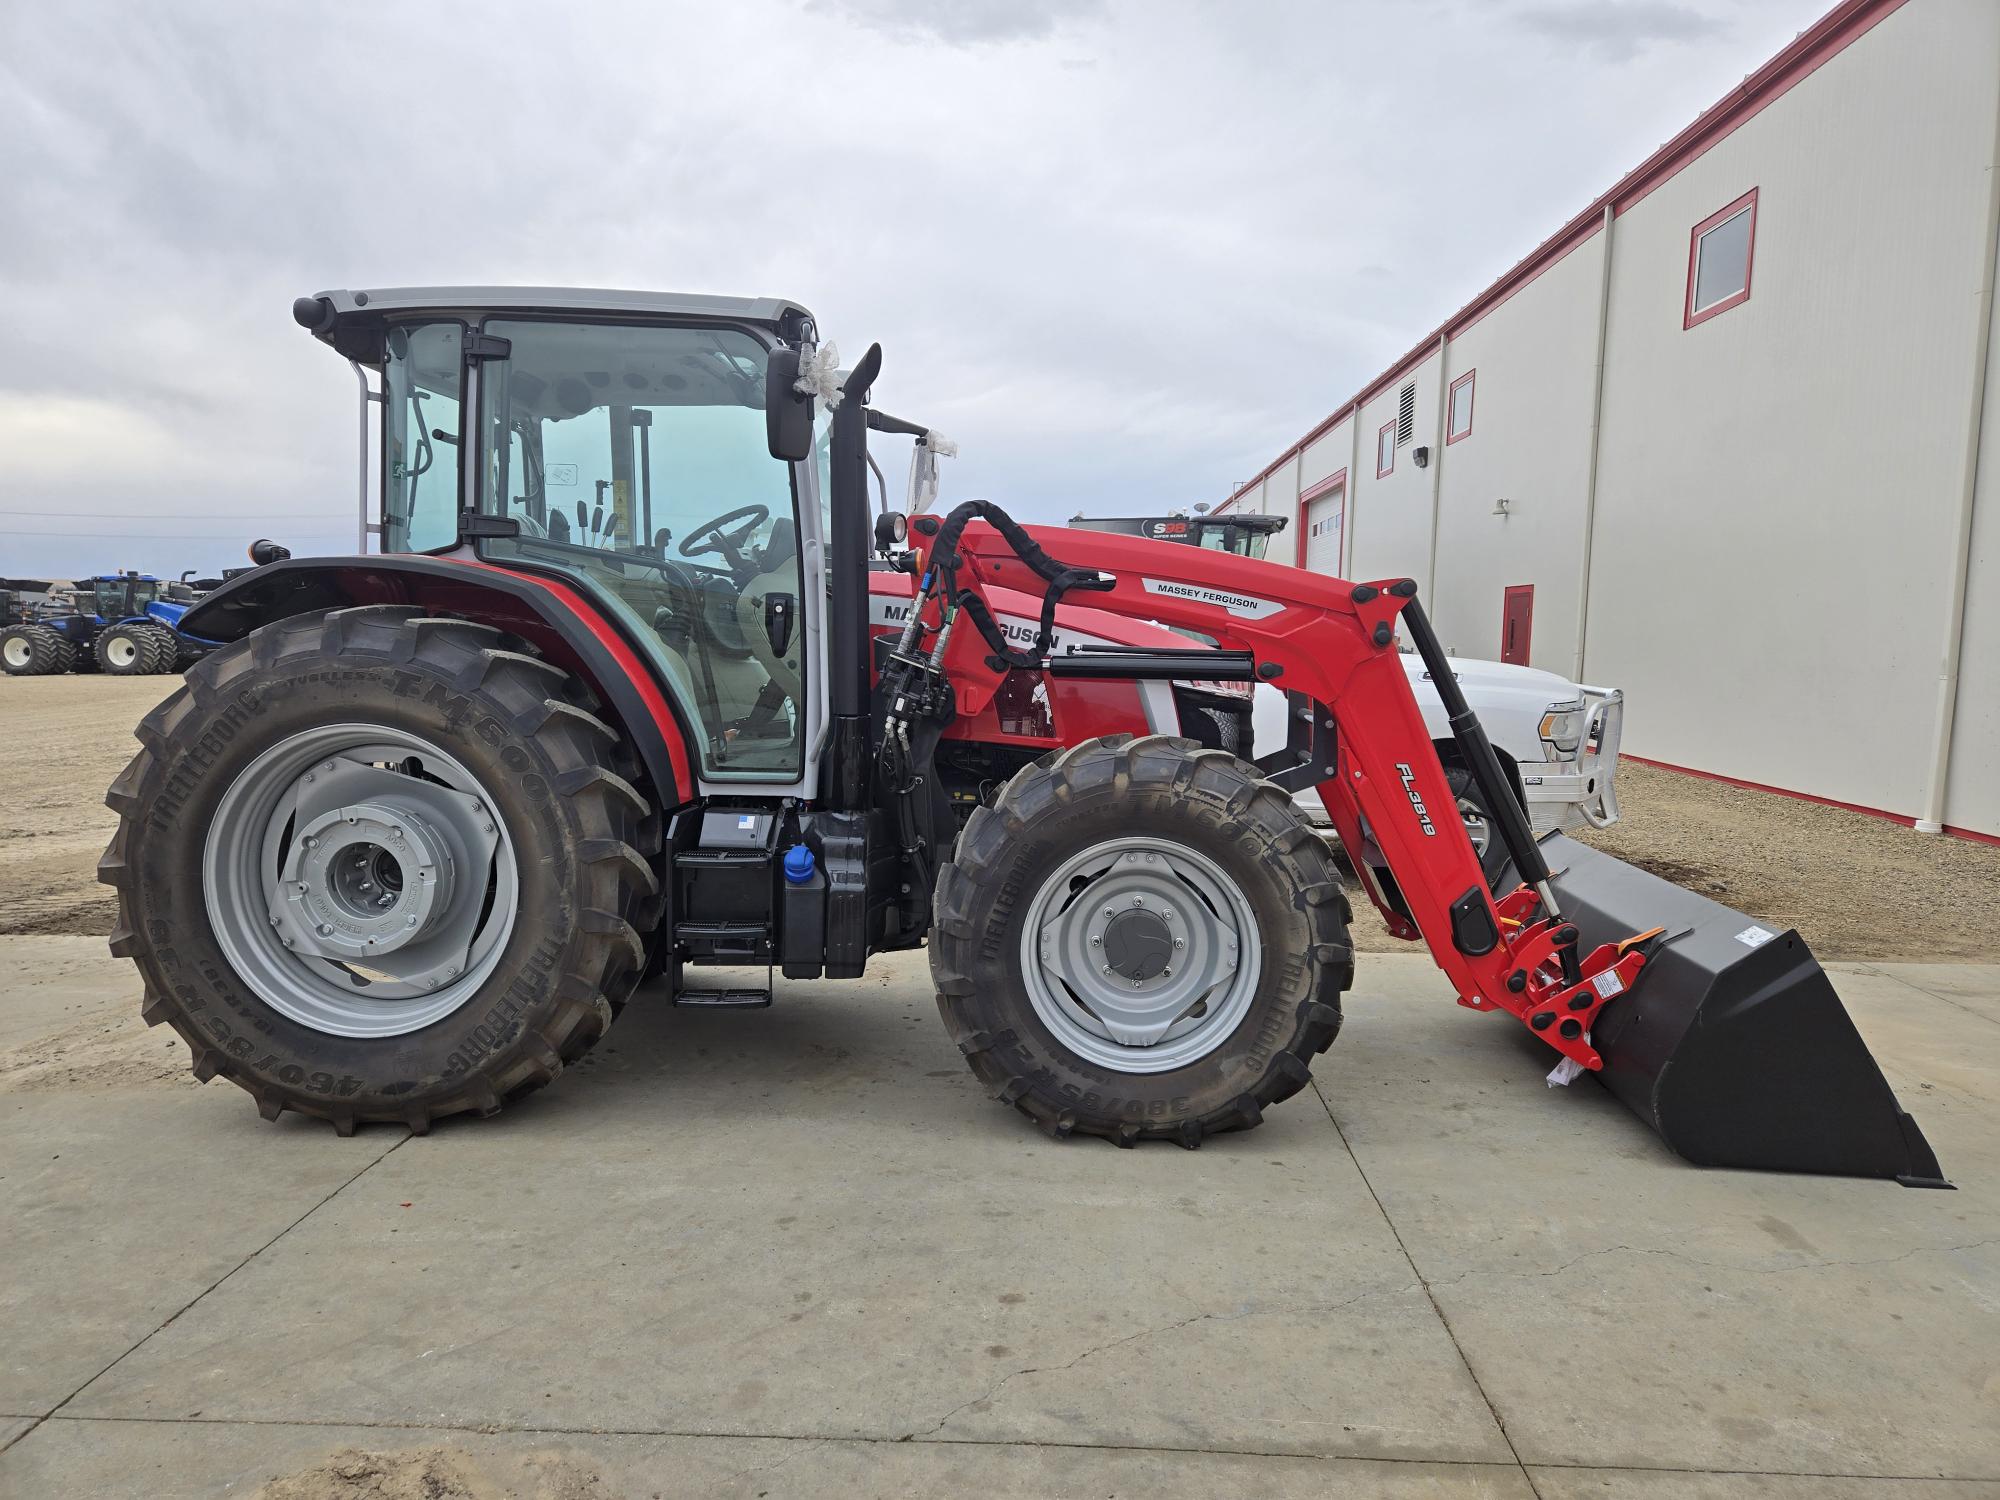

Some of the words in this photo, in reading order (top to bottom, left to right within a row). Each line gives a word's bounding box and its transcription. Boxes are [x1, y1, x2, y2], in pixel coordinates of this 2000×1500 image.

[1157, 584, 1200, 598] MASSEY
[1203, 592, 1258, 609] FERGUSON
[149, 688, 260, 833] TRELLEBORG
[1395, 762, 1437, 837] FL.3819
[979, 840, 1038, 961] TRELLEBORG
[446, 937, 566, 1074] TRELLEBORG
[1246, 952, 1308, 1074] TRELLEBORG
